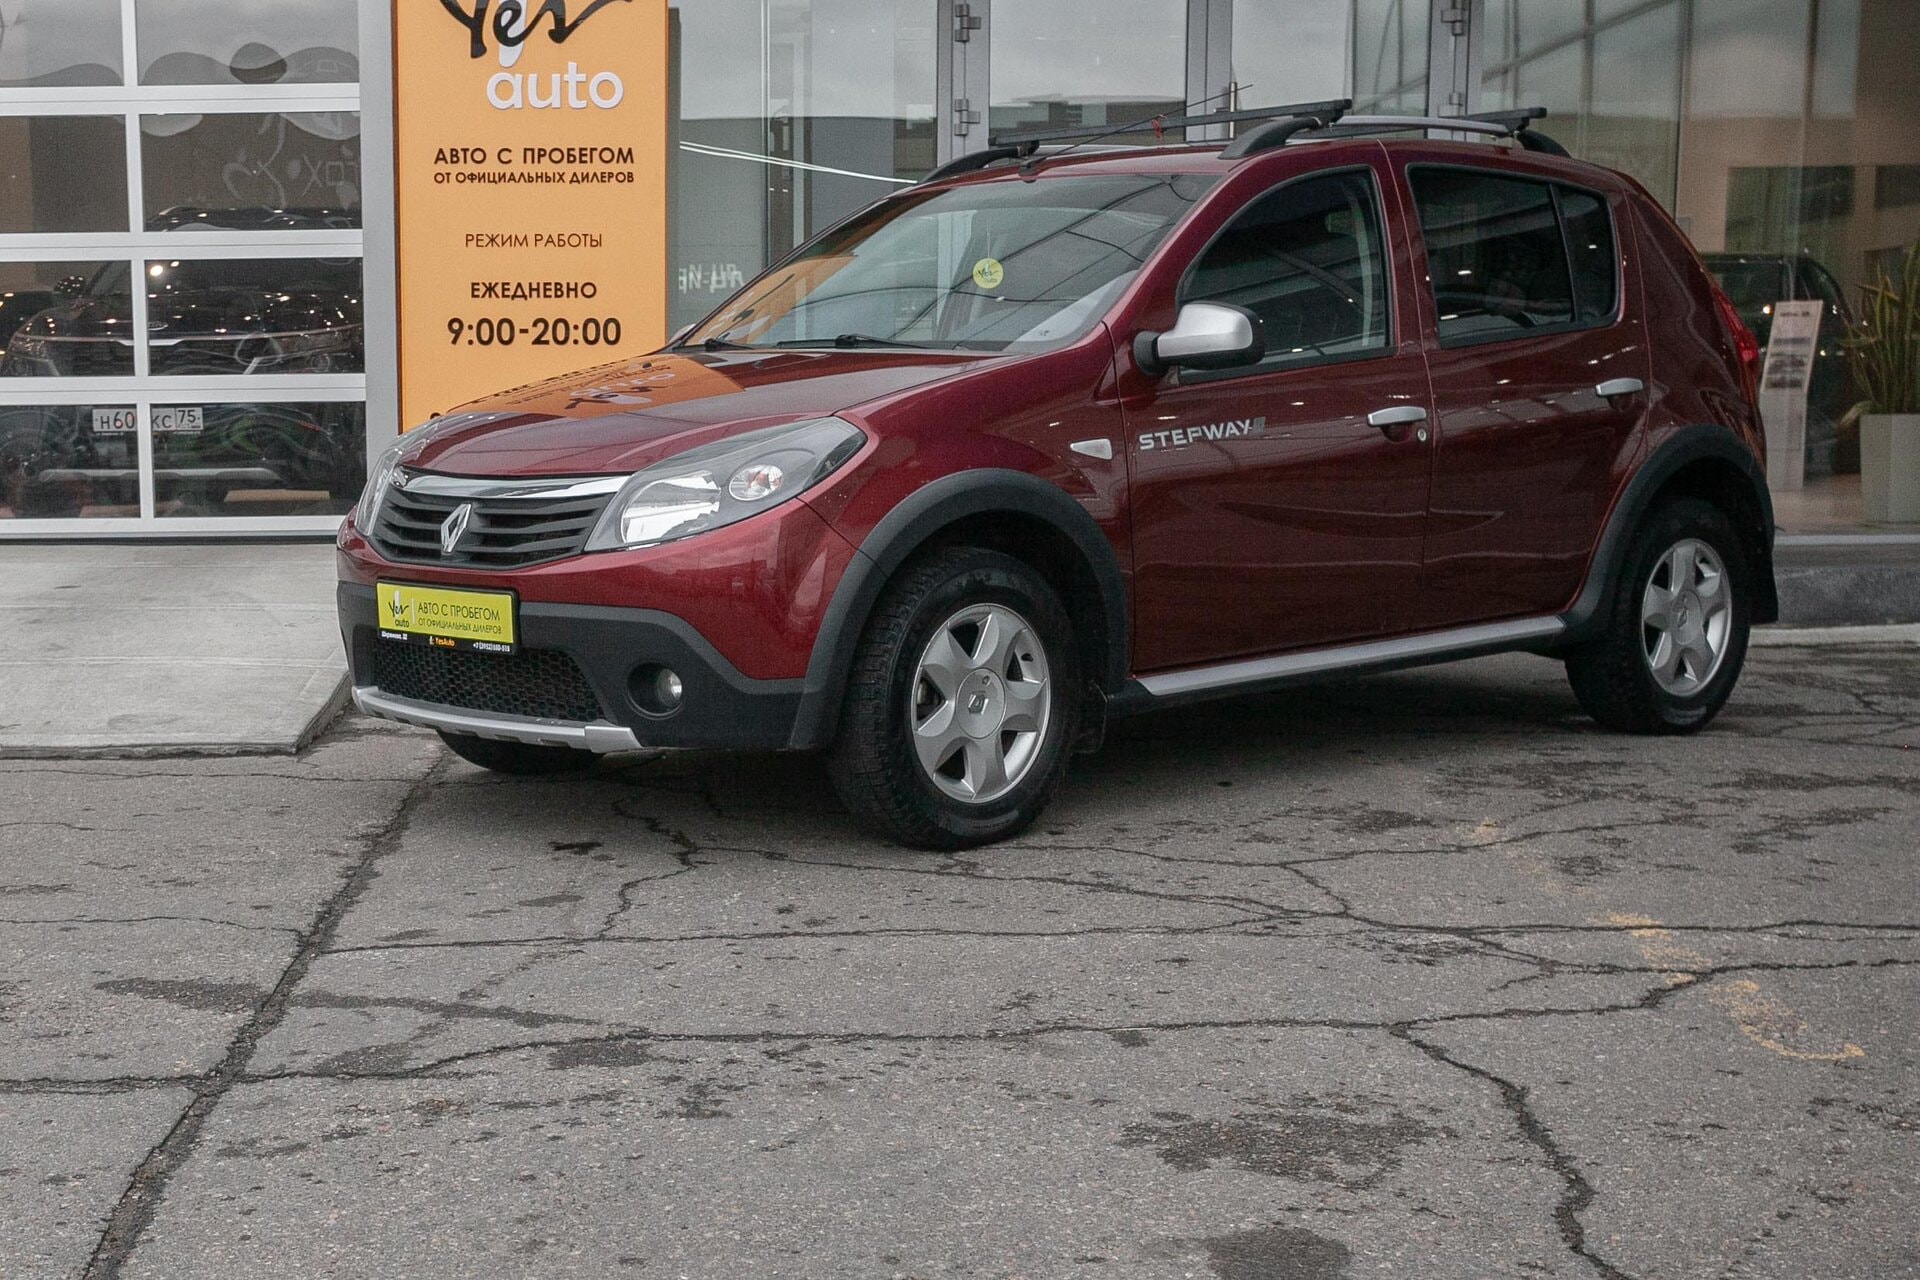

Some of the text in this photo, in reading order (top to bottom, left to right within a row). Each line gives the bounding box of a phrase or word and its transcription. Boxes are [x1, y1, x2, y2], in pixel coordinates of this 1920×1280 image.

[486, 61, 624, 110] auto
[433, 147, 635, 165] АВТО С ПРОБЕГОМ
[433, 170, 635, 186] ОТ ОФИЦИАЛЬНЫХ ДИЛЕРОВ
[464, 233, 603, 248] РЕЖИМ РАБОТЫ
[470, 281, 598, 301] ЕЖЕДНЕВНО
[447, 317, 622, 346] 9:00-20:00
[178, 409, 197, 424] 75
[1139, 419, 1252, 451] STEPWAY
[417, 601, 501, 622] АВТО С ПРОБЕГОМ
[394, 619, 410, 629] auto
[417, 617, 503, 635] ОТ ОФИЦИАЛЬНЫХ ДИЛЕРОВ
